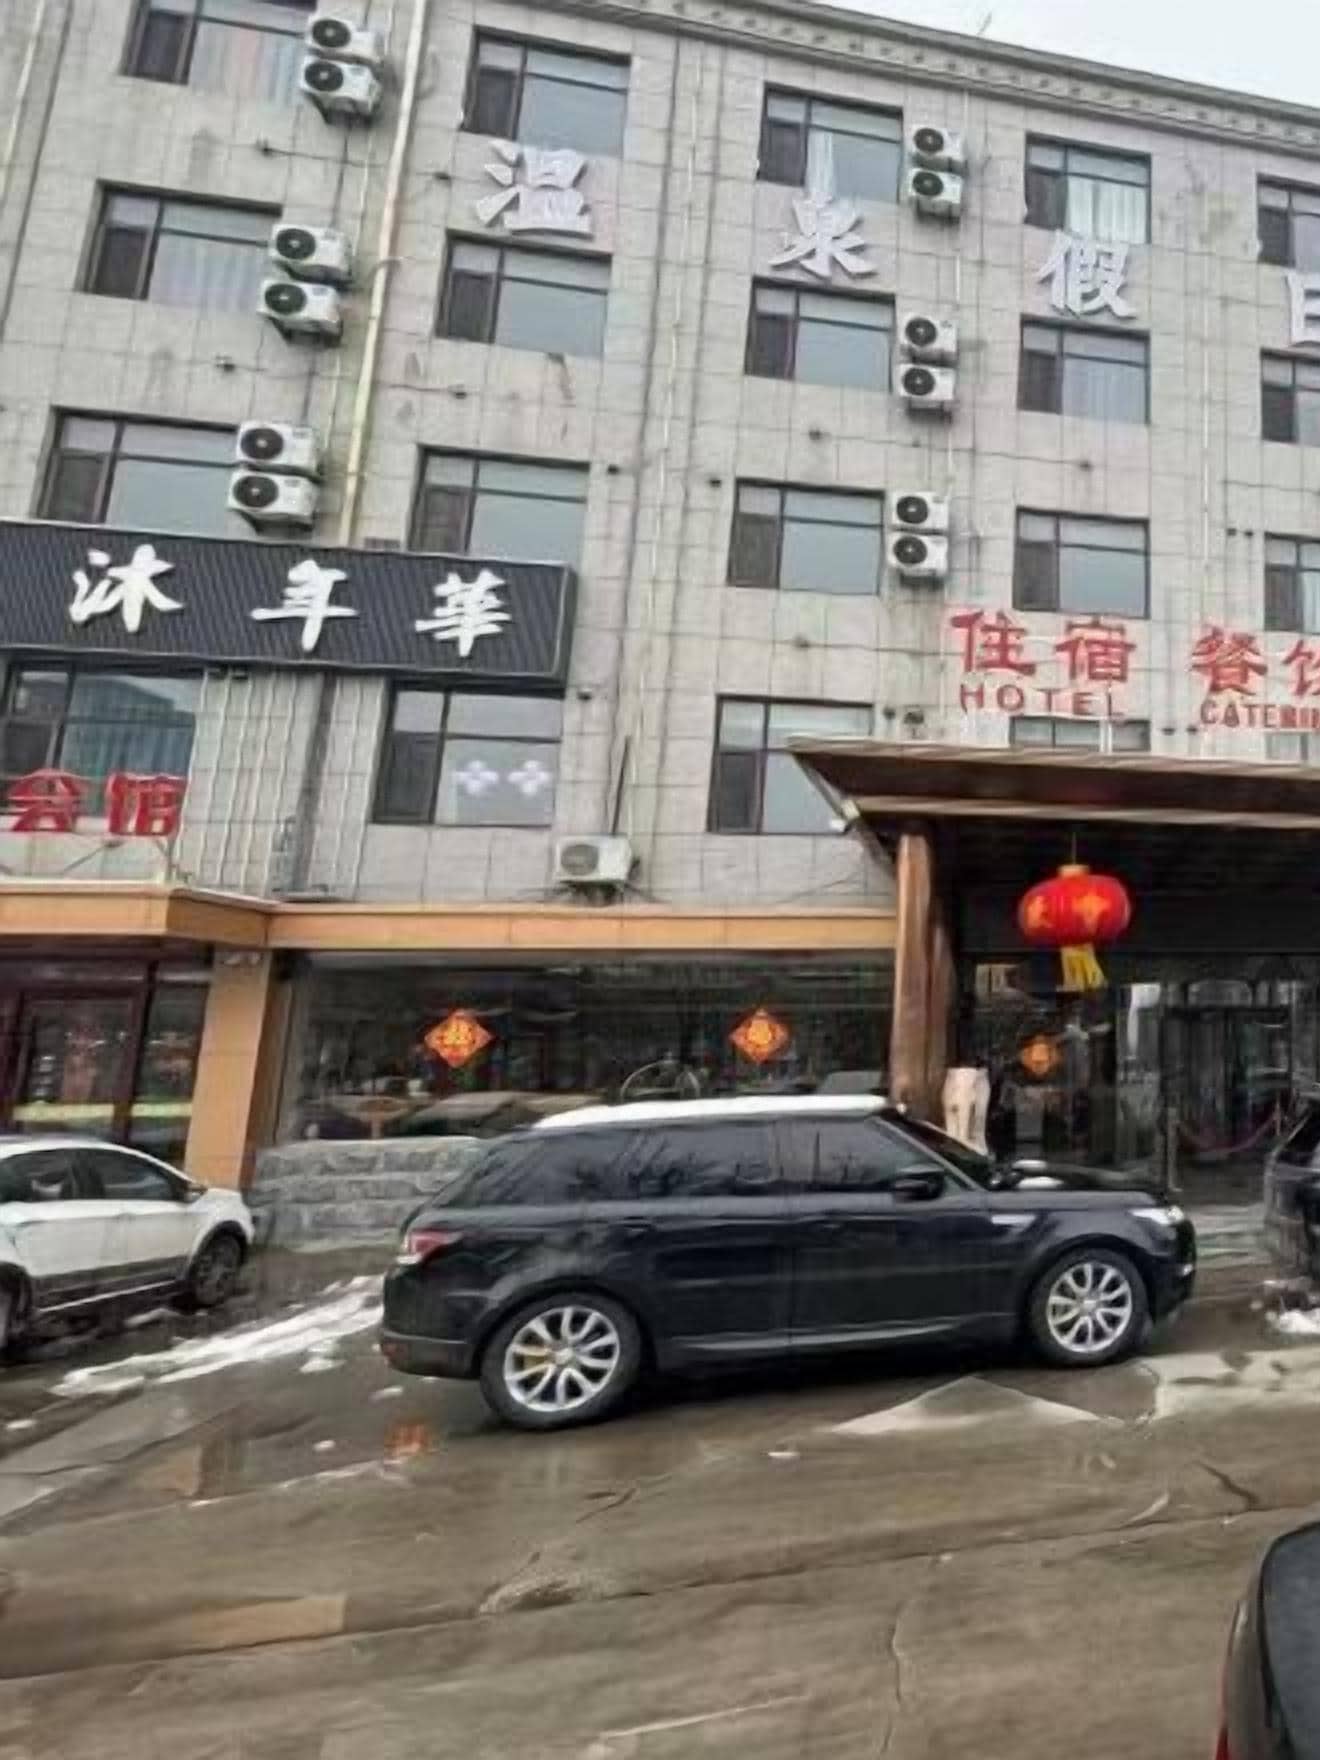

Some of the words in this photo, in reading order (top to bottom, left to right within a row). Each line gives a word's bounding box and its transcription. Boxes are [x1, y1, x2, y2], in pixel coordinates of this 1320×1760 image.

[951, 609, 1138, 682] 住宿
[959, 682, 1126, 723] HOTEL
[8, 770, 186, 837] 会馆
